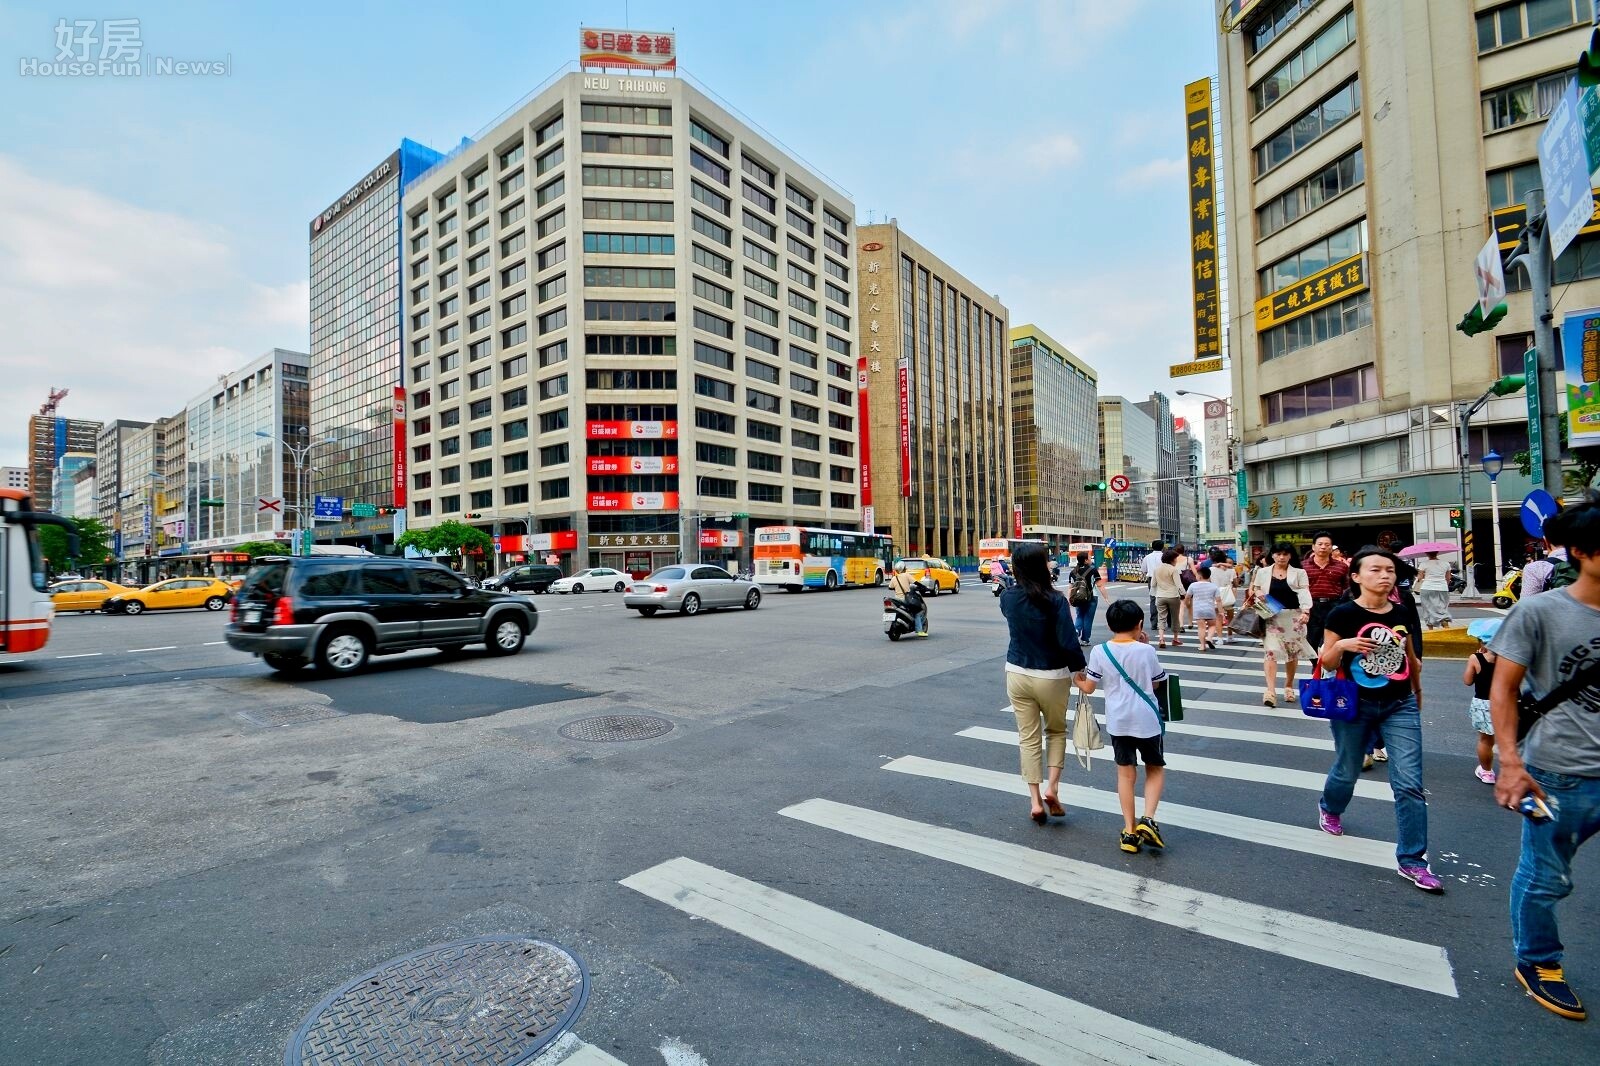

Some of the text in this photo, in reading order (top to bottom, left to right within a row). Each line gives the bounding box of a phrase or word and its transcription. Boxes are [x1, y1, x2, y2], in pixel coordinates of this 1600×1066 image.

[602, 33, 671, 54] 日盛金控
[584, 77, 667, 93] NEW TAIHONG
[1175, 361, 1220, 375] 0800-221-555
[1270, 489, 1366, 517] 臺灣銀行
[1559, 644, 1590, 675] BIG
